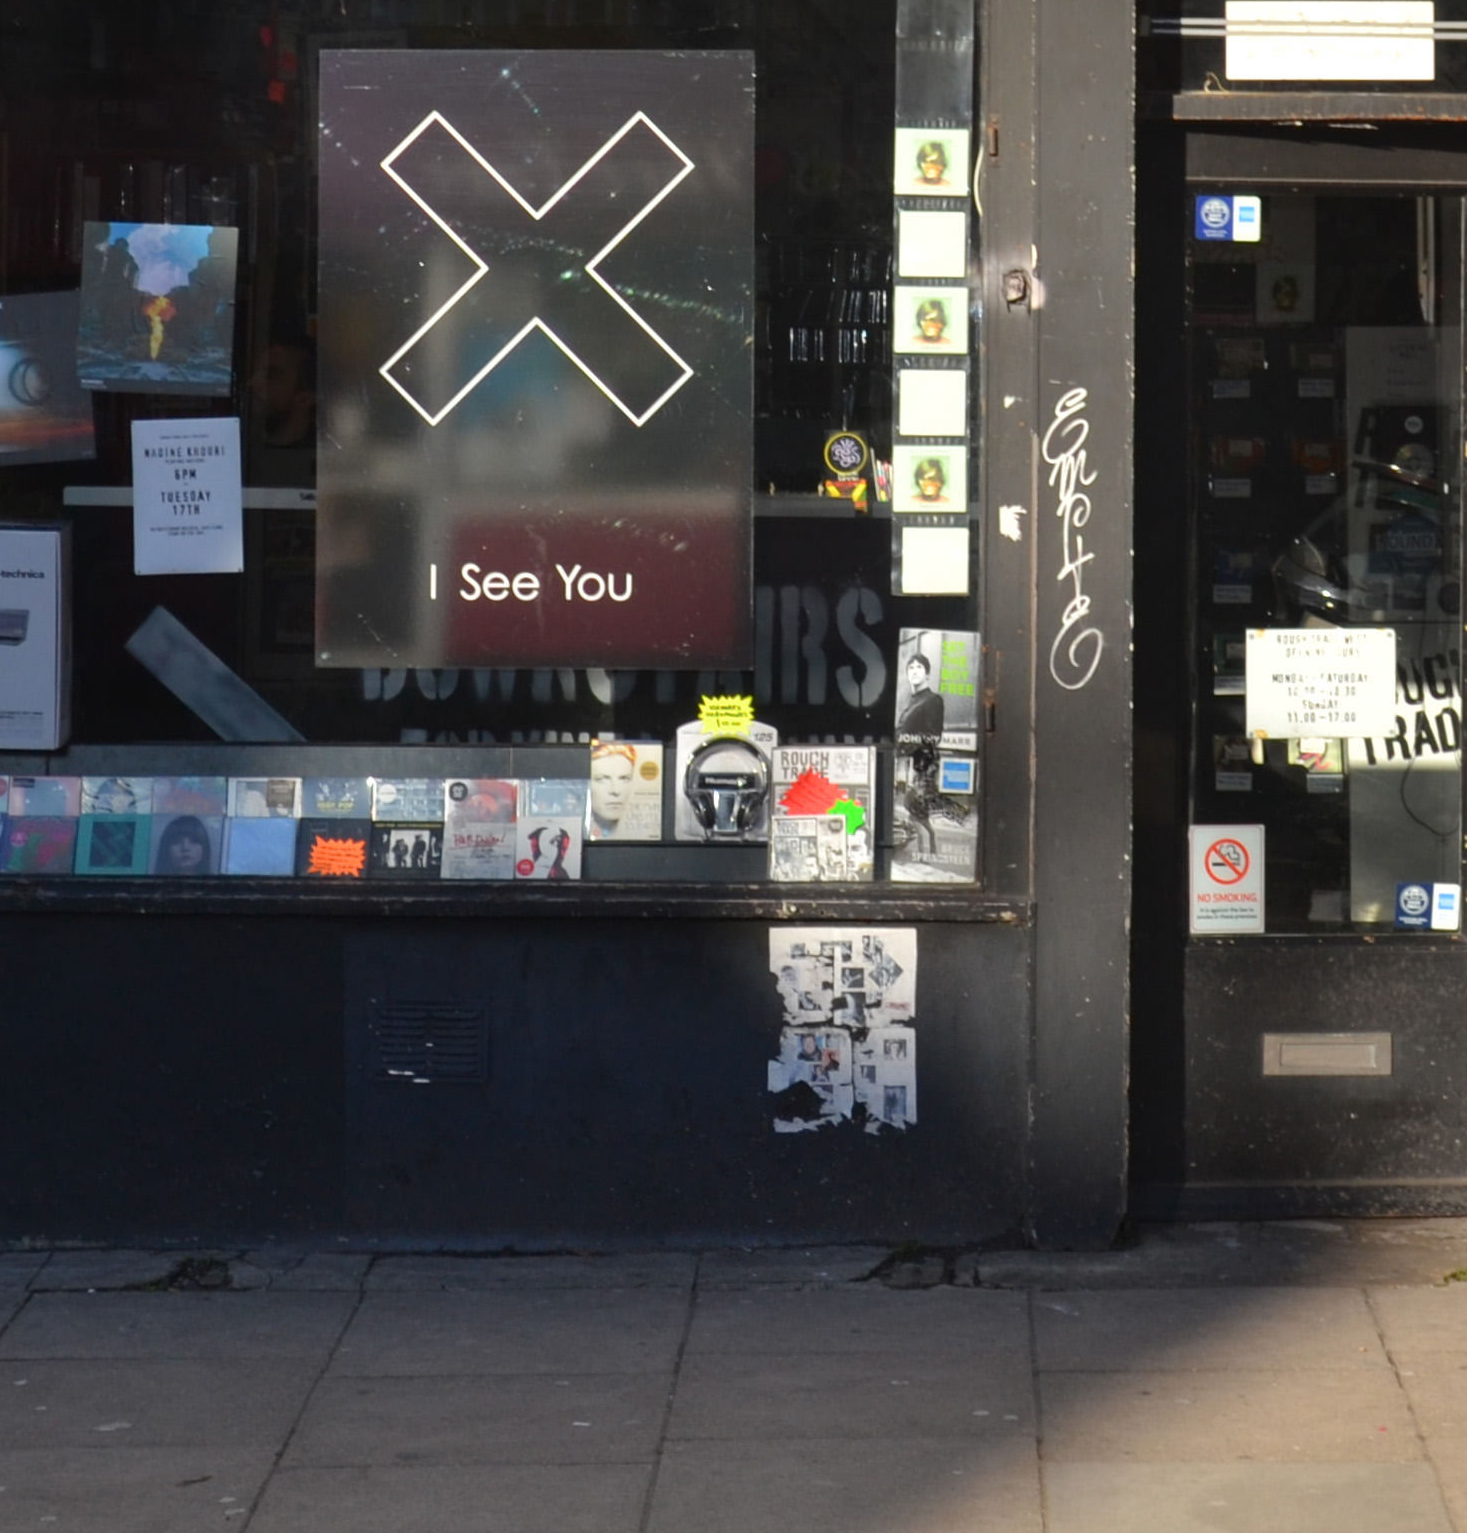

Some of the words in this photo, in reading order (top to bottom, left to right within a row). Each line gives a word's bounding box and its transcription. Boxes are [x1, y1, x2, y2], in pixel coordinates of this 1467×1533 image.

[144, 446, 182, 458] NADINE
[174, 468, 197, 480] 6PM
[160, 490, 211, 503] TUESDAY
[172, 504, 201, 516] 17TH
[429, 563, 437, 601] I
[459, 563, 540, 601] See
[555, 563, 634, 601] You
[942, 640, 966, 654] SET
[942, 654, 969, 668] THE
[941, 668, 970, 682] BOY
[940, 682, 975, 696] FREE
[752, 732, 774, 742] 125
[941, 736, 972, 748] MARR
[781, 751, 830, 767] ROUGH
[782, 766, 830, 780] TRE
[1197, 892, 1211, 903] NO
[1213, 892, 1258, 903] SMOKING
